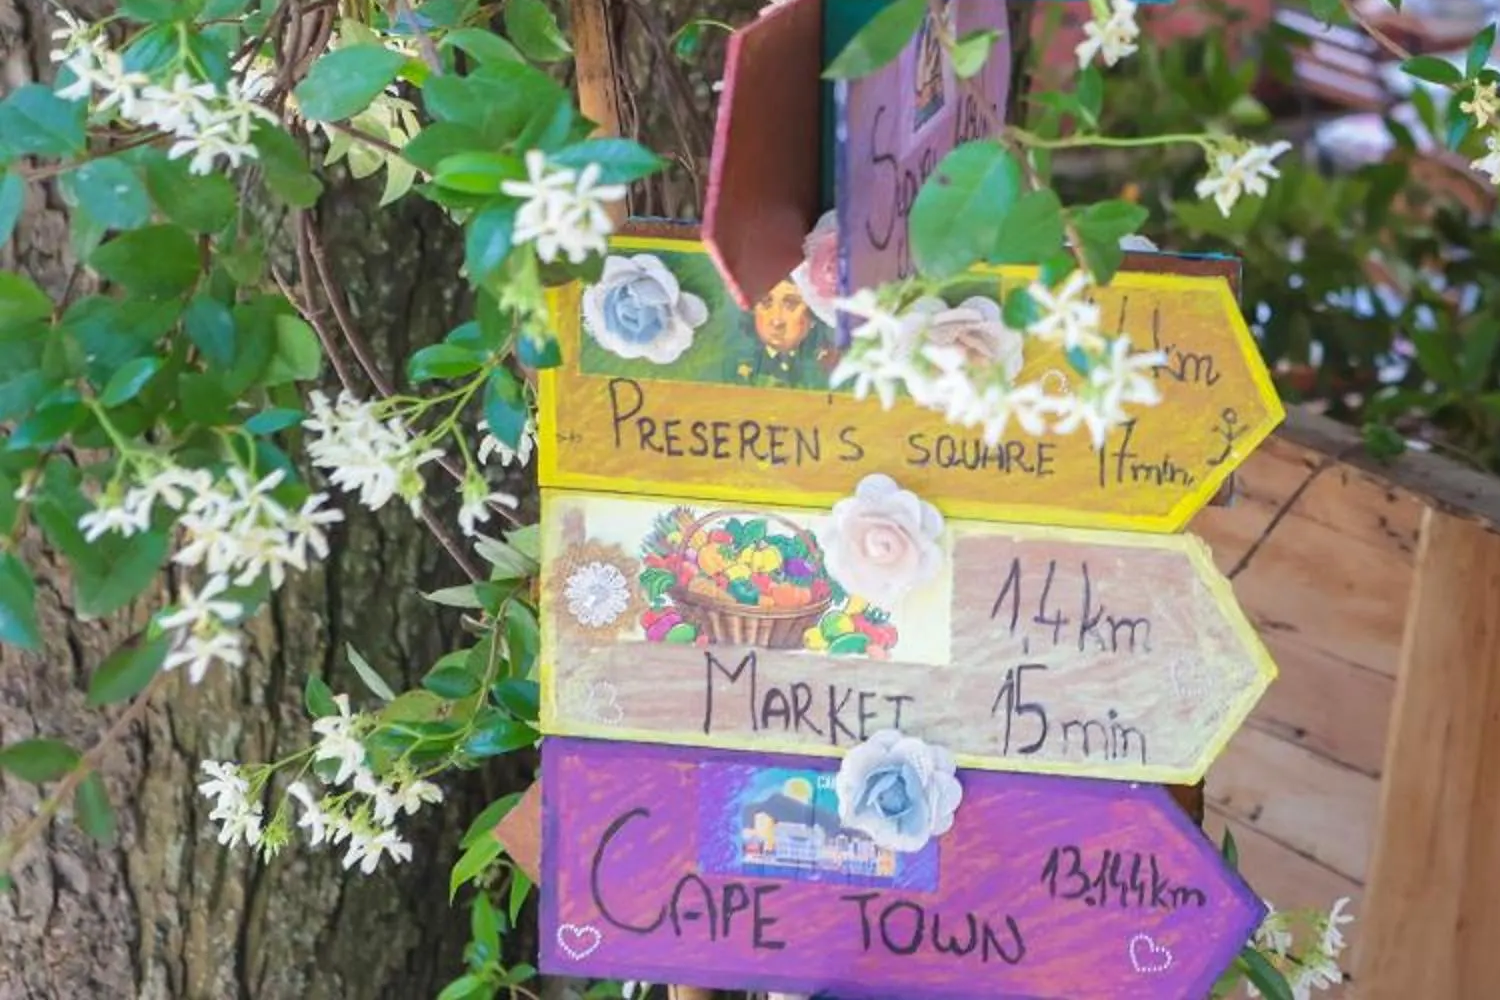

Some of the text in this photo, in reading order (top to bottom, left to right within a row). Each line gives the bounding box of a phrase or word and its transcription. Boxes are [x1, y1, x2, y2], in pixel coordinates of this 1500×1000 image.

[906, 432, 1058, 477] SQUARE
[990, 556, 1152, 655] 1,4km
[703, 649, 915, 746] MARKET
[590, 807, 1028, 966] CAPE TOWN
